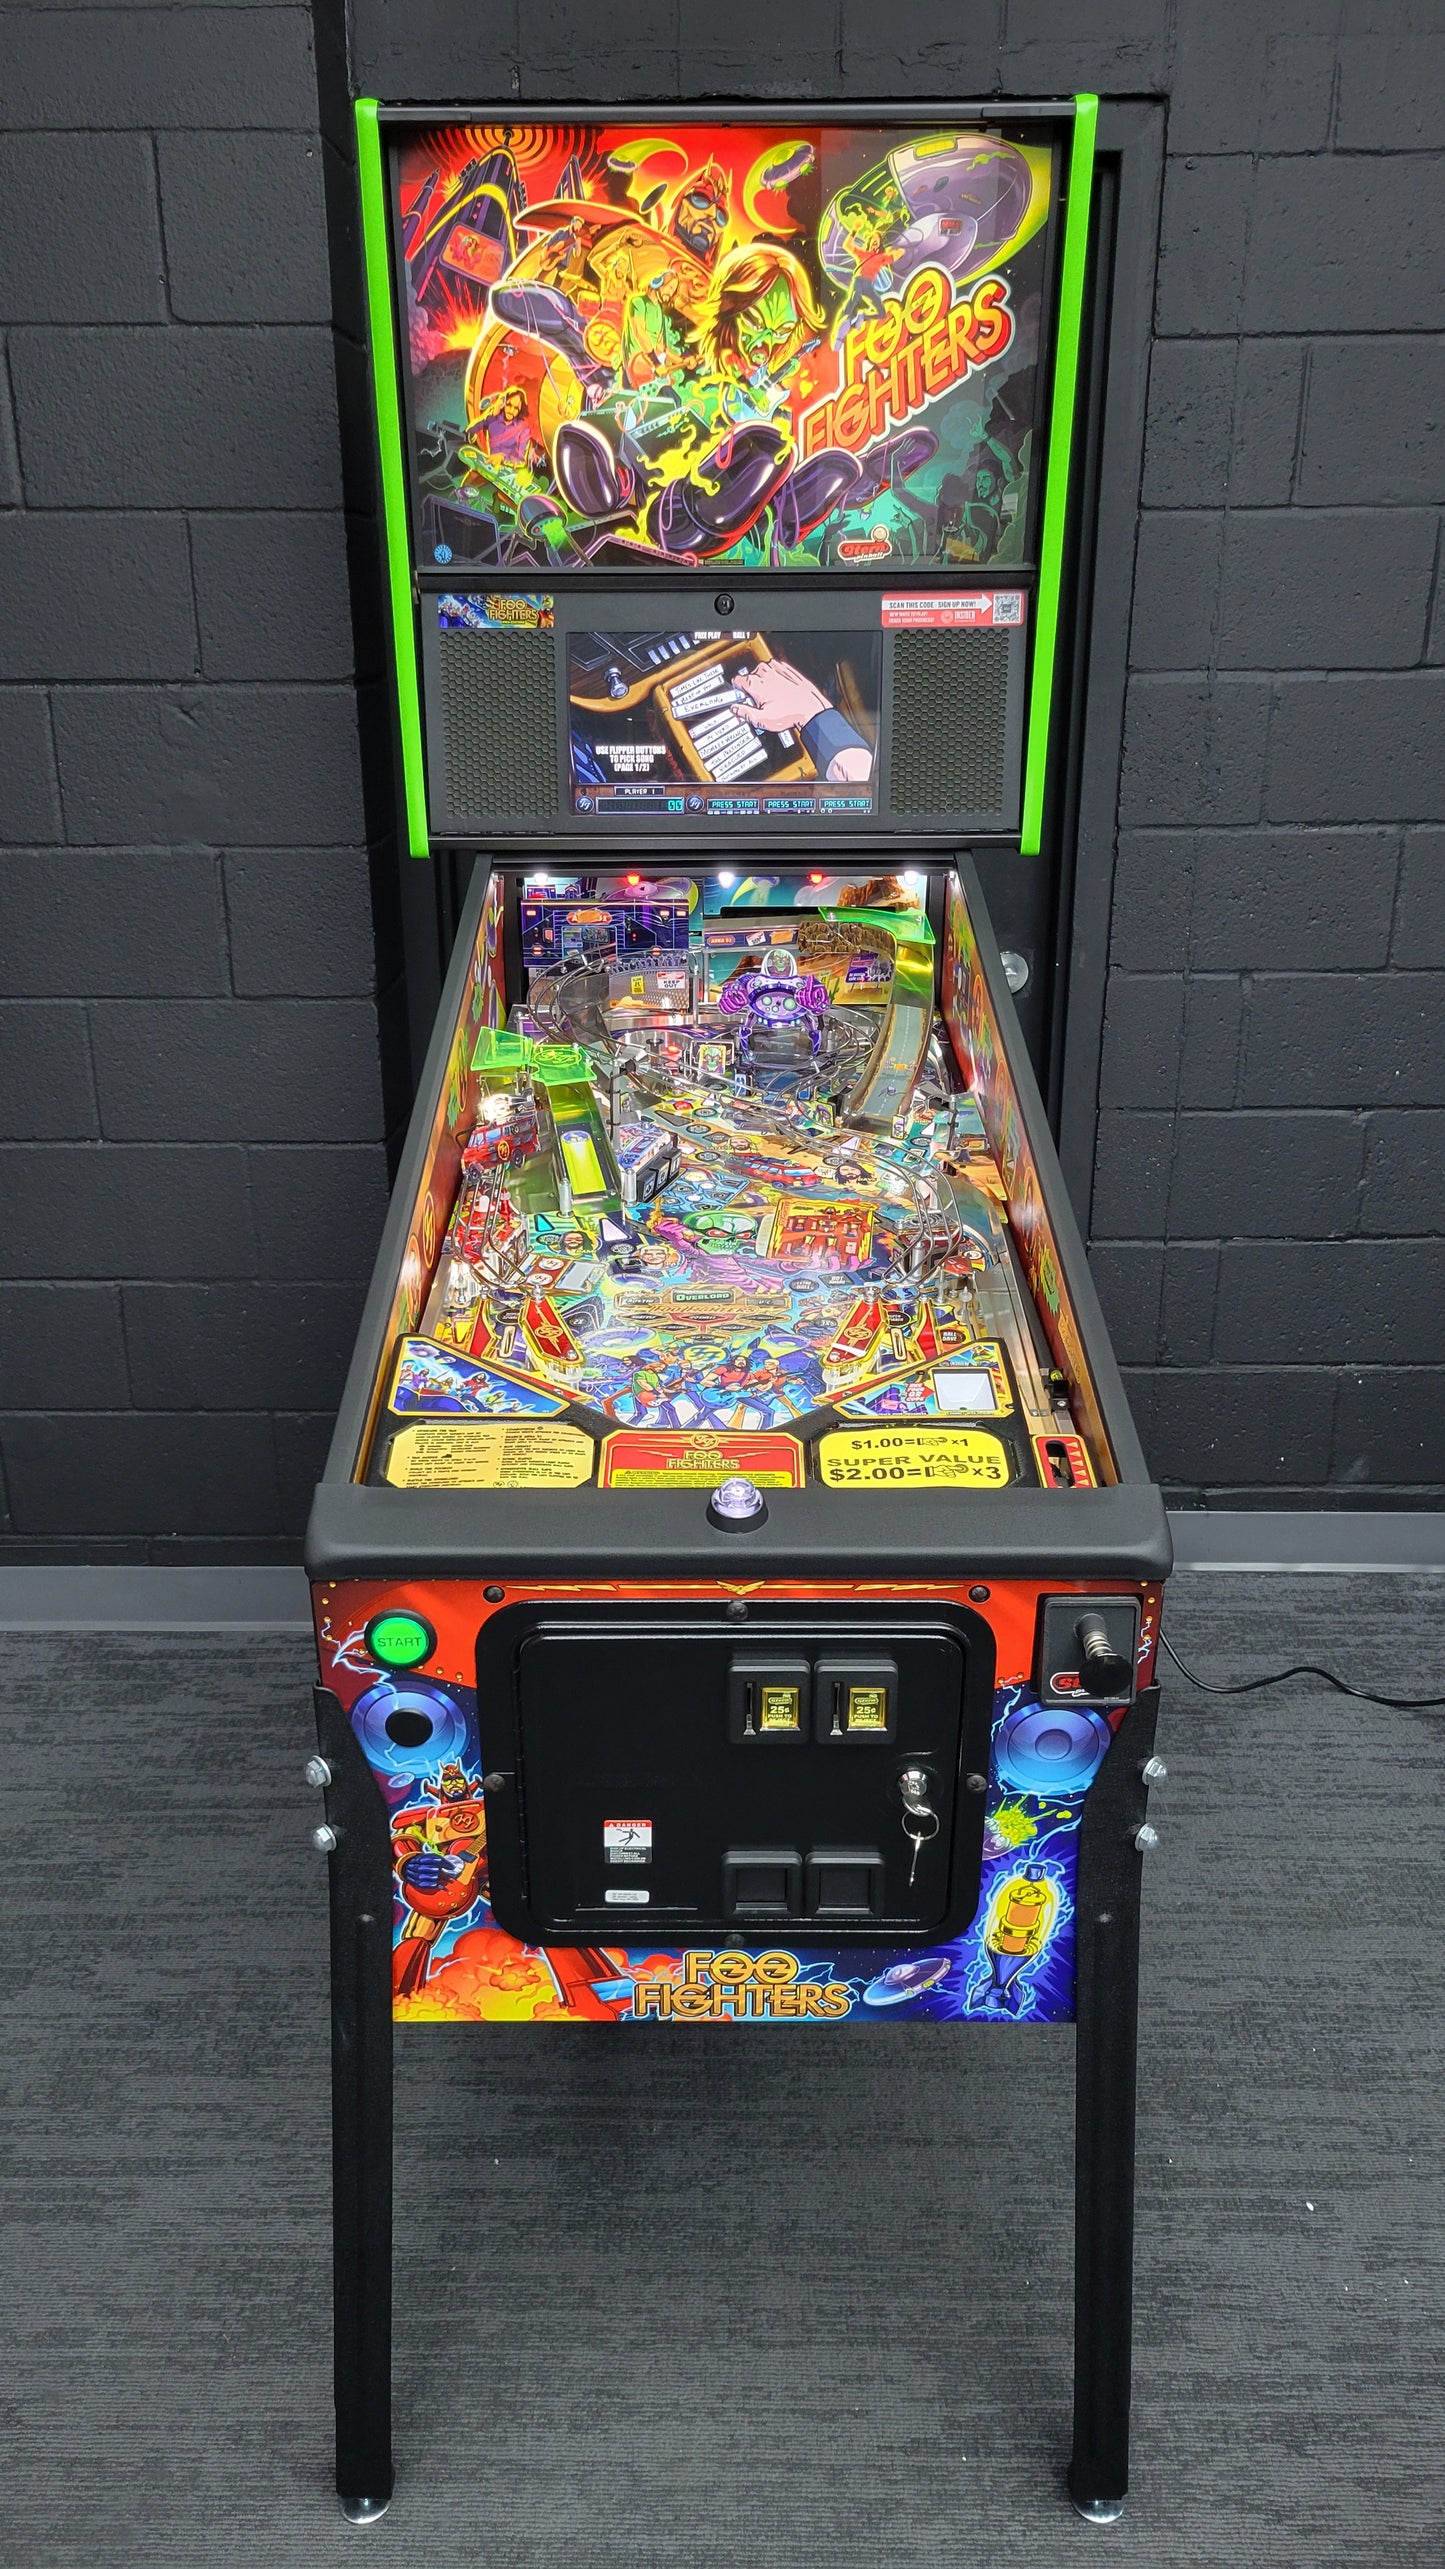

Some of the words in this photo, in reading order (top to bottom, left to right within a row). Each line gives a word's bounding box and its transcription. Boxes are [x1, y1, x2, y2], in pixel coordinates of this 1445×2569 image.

[844, 267, 951, 384] FOO
[804, 278, 1012, 459] FIGHTERS
[499, 599, 526, 610] FOO
[960, 600, 976, 608] NOW!
[489, 609, 539, 620] FIGHTERS
[684, 696, 724, 713] EVERLONG
[596, 746, 609, 754] USE
[610, 746, 635, 754] FLIPPER
[636, 746, 666, 754] BUTTONS
[610, 754, 619, 764] TO
[620, 754, 636, 764] PICK
[636, 754, 654, 764] SONG
[824, 800, 846, 808] PRESS
[850, 800, 870, 808] START
[676, 1292, 730, 1302] OVERLORD
[684, 1450, 723, 1460] FOO
[827, 1454, 910, 1467] SUPER
[918, 1454, 1001, 1465] VALUE
[666, 1459, 740, 1470] FIGHTERS
[377, 1636, 422, 1648] START
[770, 1706, 790, 1714] 25¢
[856, 1706, 876, 1714] 25¢
[683, 1951, 799, 1985] FOO
[634, 1983, 851, 2018] FIGHTERS
